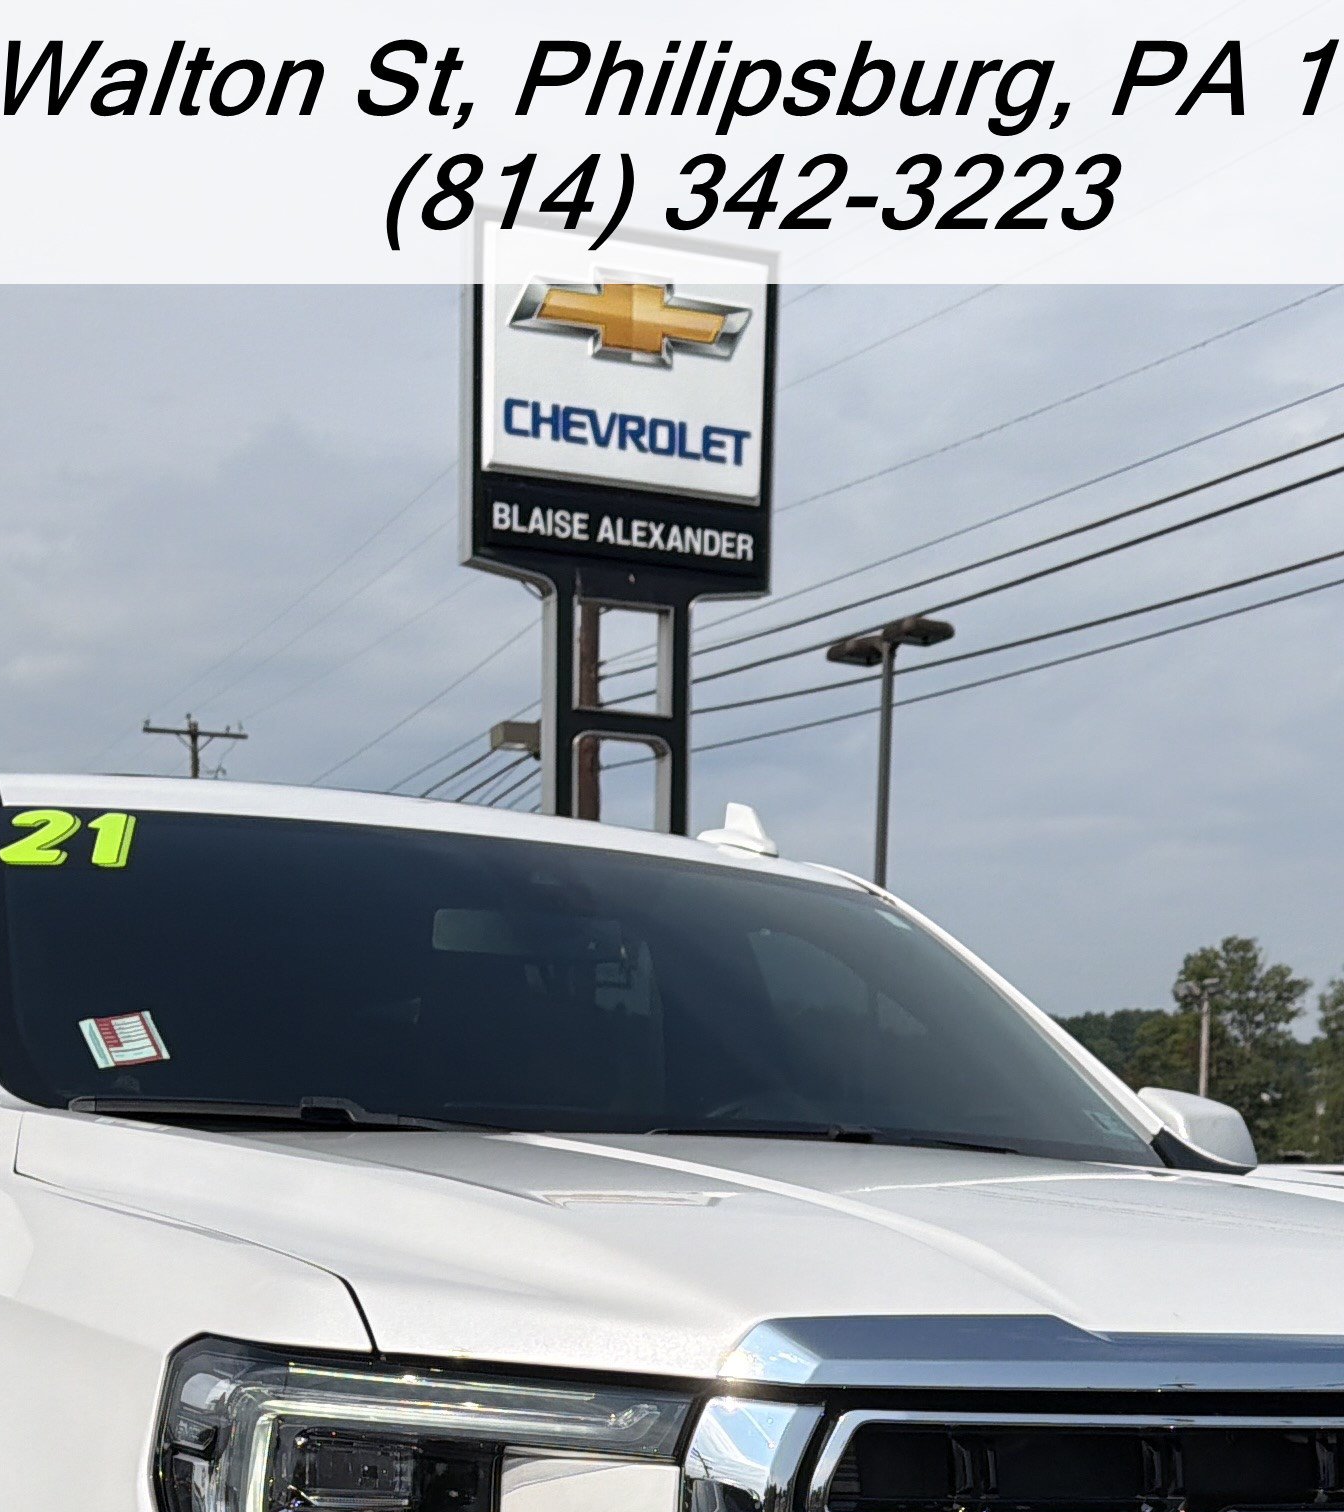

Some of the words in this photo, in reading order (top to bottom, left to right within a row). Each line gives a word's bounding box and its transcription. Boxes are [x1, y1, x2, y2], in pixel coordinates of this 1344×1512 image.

[502, 397, 752, 467] CHEVROLET
[491, 500, 590, 542] BLAISE
[595, 515, 754, 563] ALEXANDER
